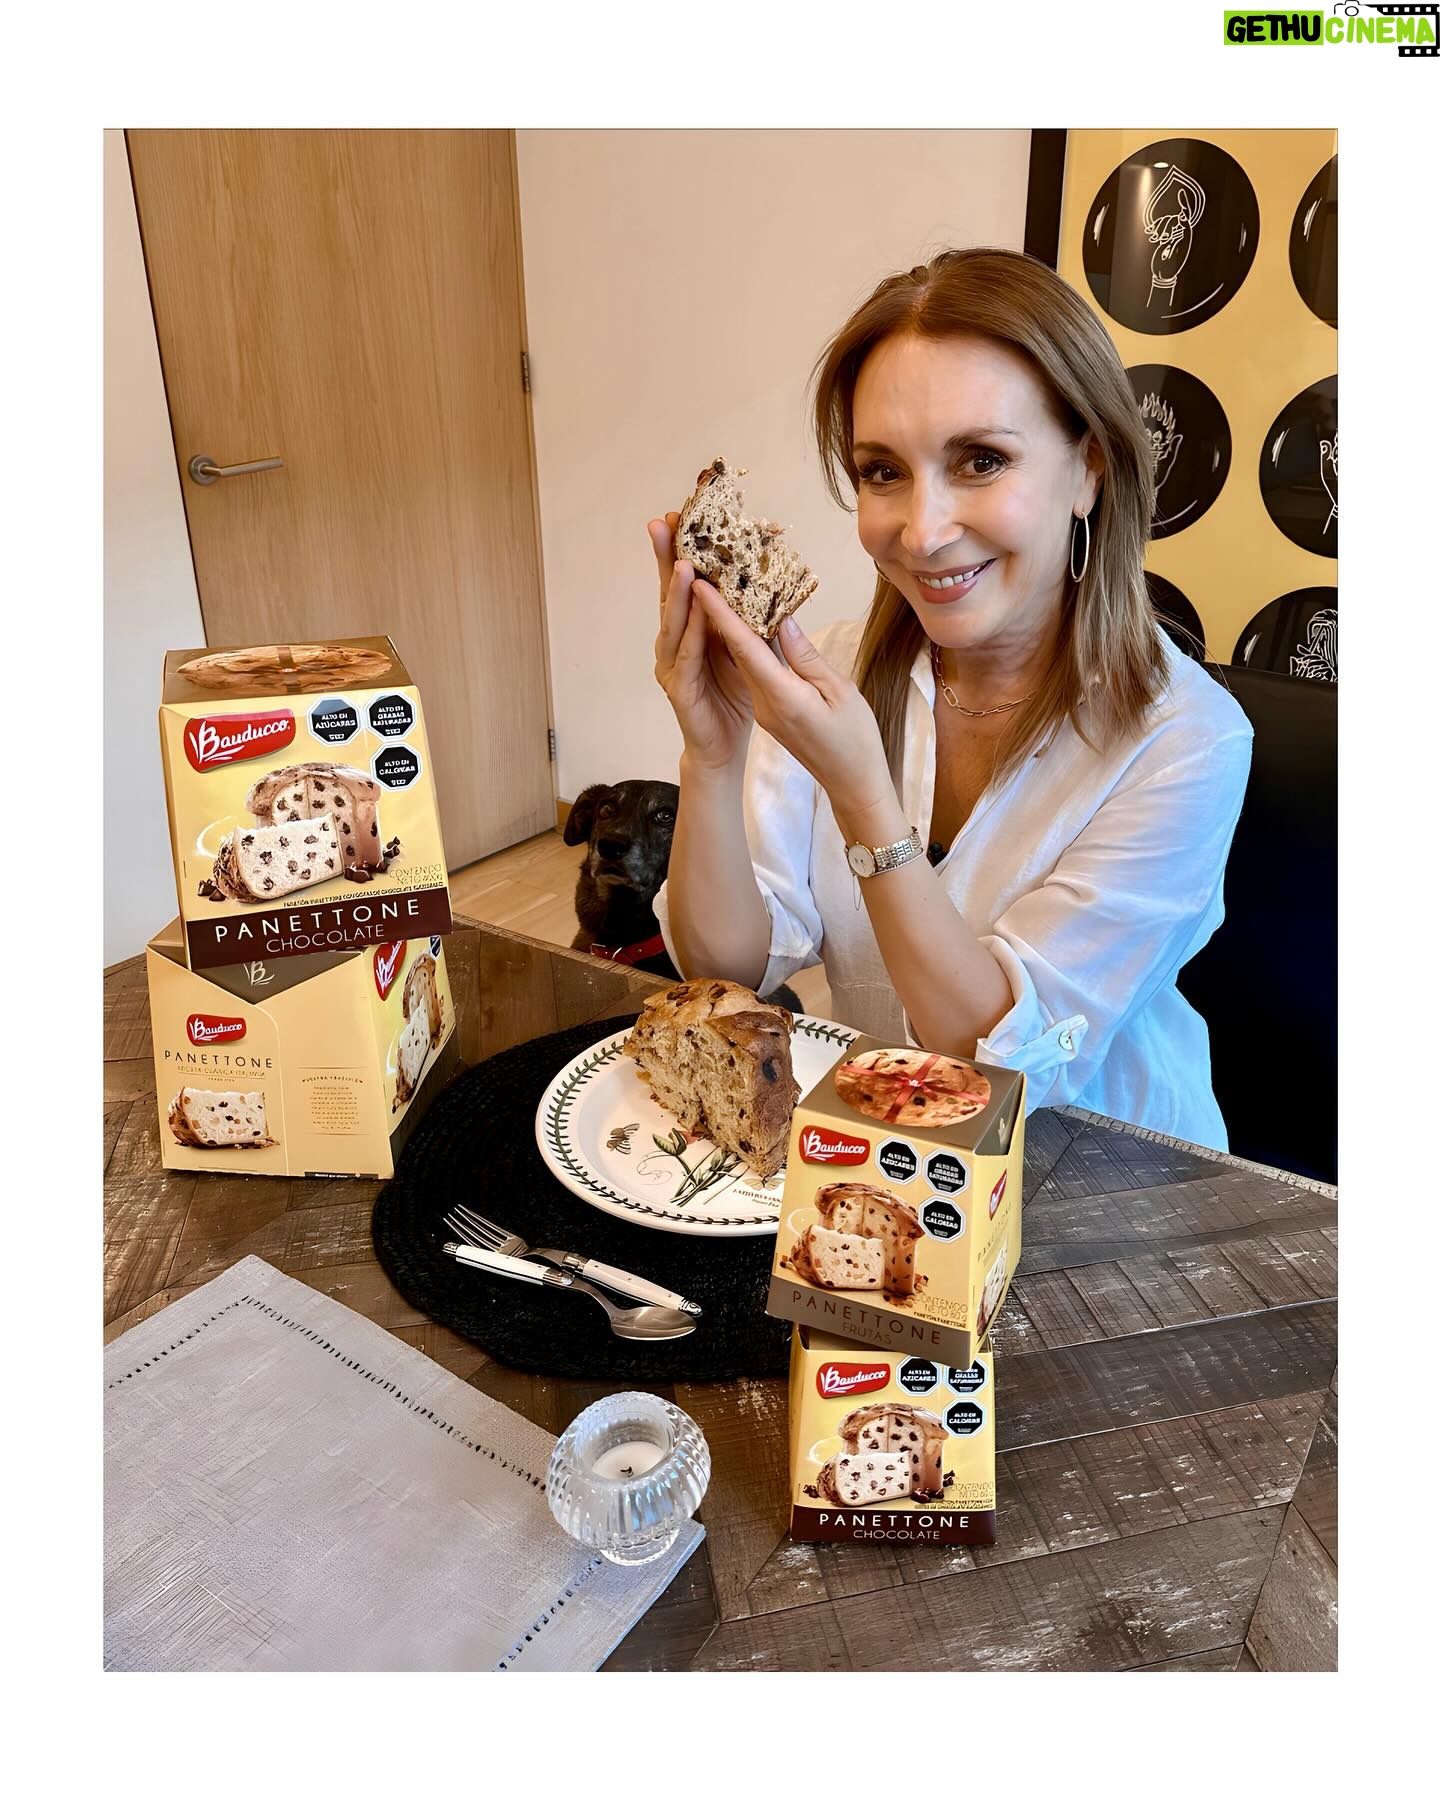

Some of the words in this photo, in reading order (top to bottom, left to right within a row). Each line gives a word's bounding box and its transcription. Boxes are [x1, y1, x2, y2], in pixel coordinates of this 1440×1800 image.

[188, 718, 291, 764] Bauducco
[214, 898, 420, 943] PANETTONE
[265, 922, 385, 954] CHOCOLATE
[188, 1017, 243, 1042] Bauducco
[164, 1050, 273, 1069] PANETTONE
[802, 1129, 867, 1162] Bauducco
[792, 1290, 942, 1345] PANETTONE
[842, 1321, 893, 1346] FRUTAS
[820, 1366, 888, 1393] Bauducco
[819, 1513, 969, 1528] PANETTONE
[853, 1529, 941, 1540] CHOCOLATE
